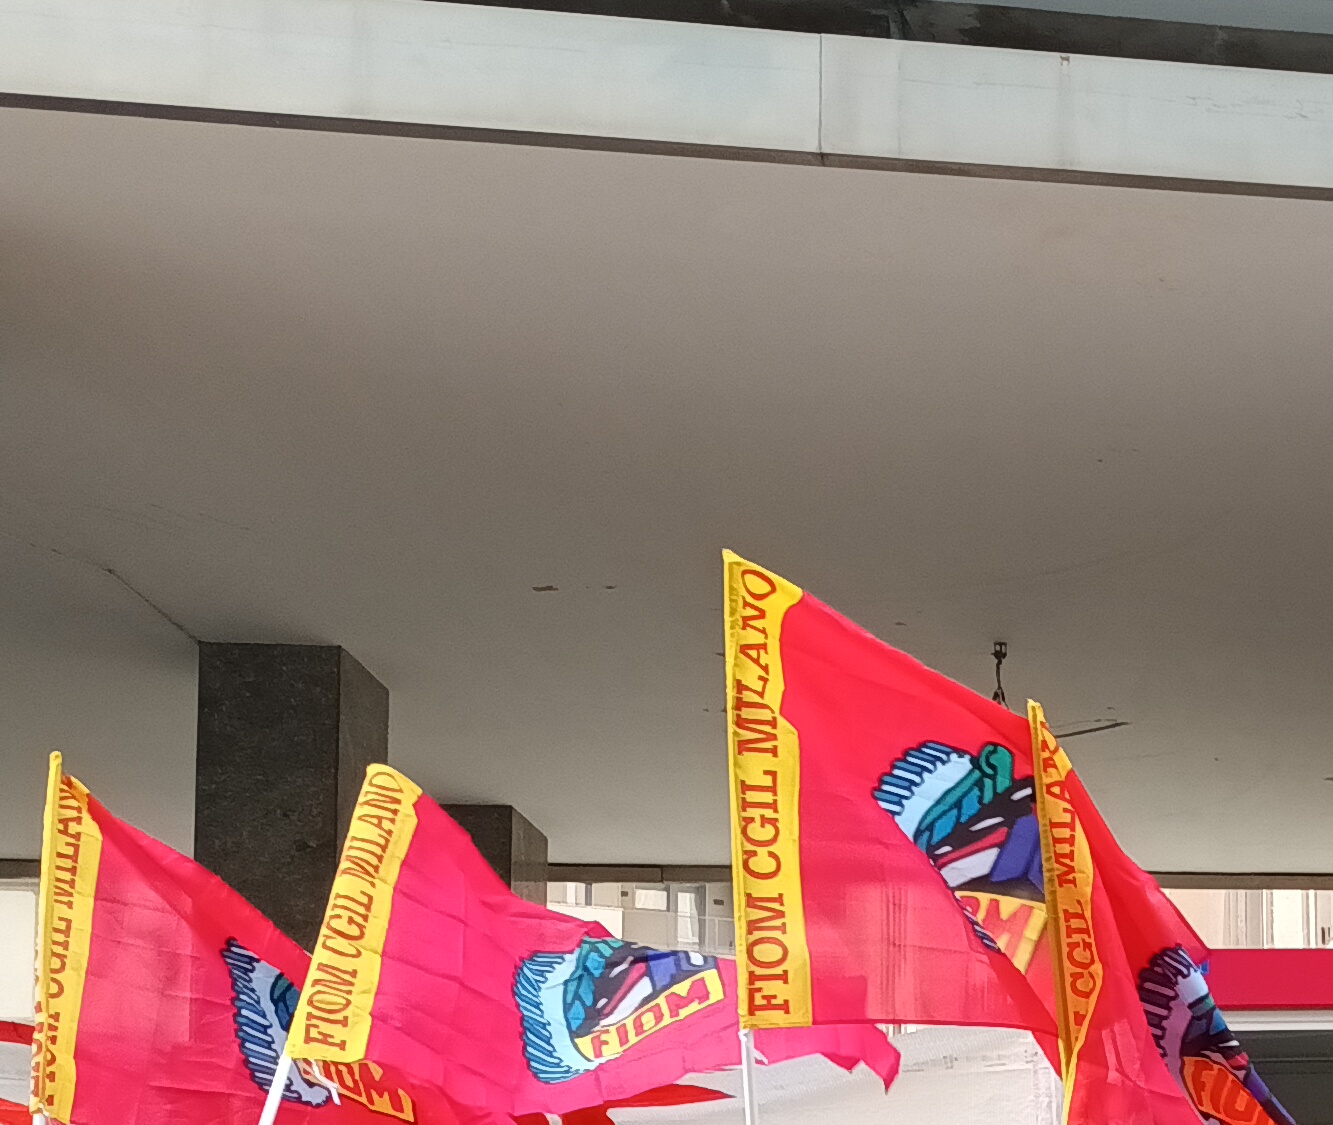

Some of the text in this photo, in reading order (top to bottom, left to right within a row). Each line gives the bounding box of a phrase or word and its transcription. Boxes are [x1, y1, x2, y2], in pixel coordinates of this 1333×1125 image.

[735, 569, 790, 1017] FIOM CGIL MILANO
[321, 892, 374, 959] CGIL
[303, 961, 358, 1051] FIOM
[590, 976, 711, 1060] FIOM
